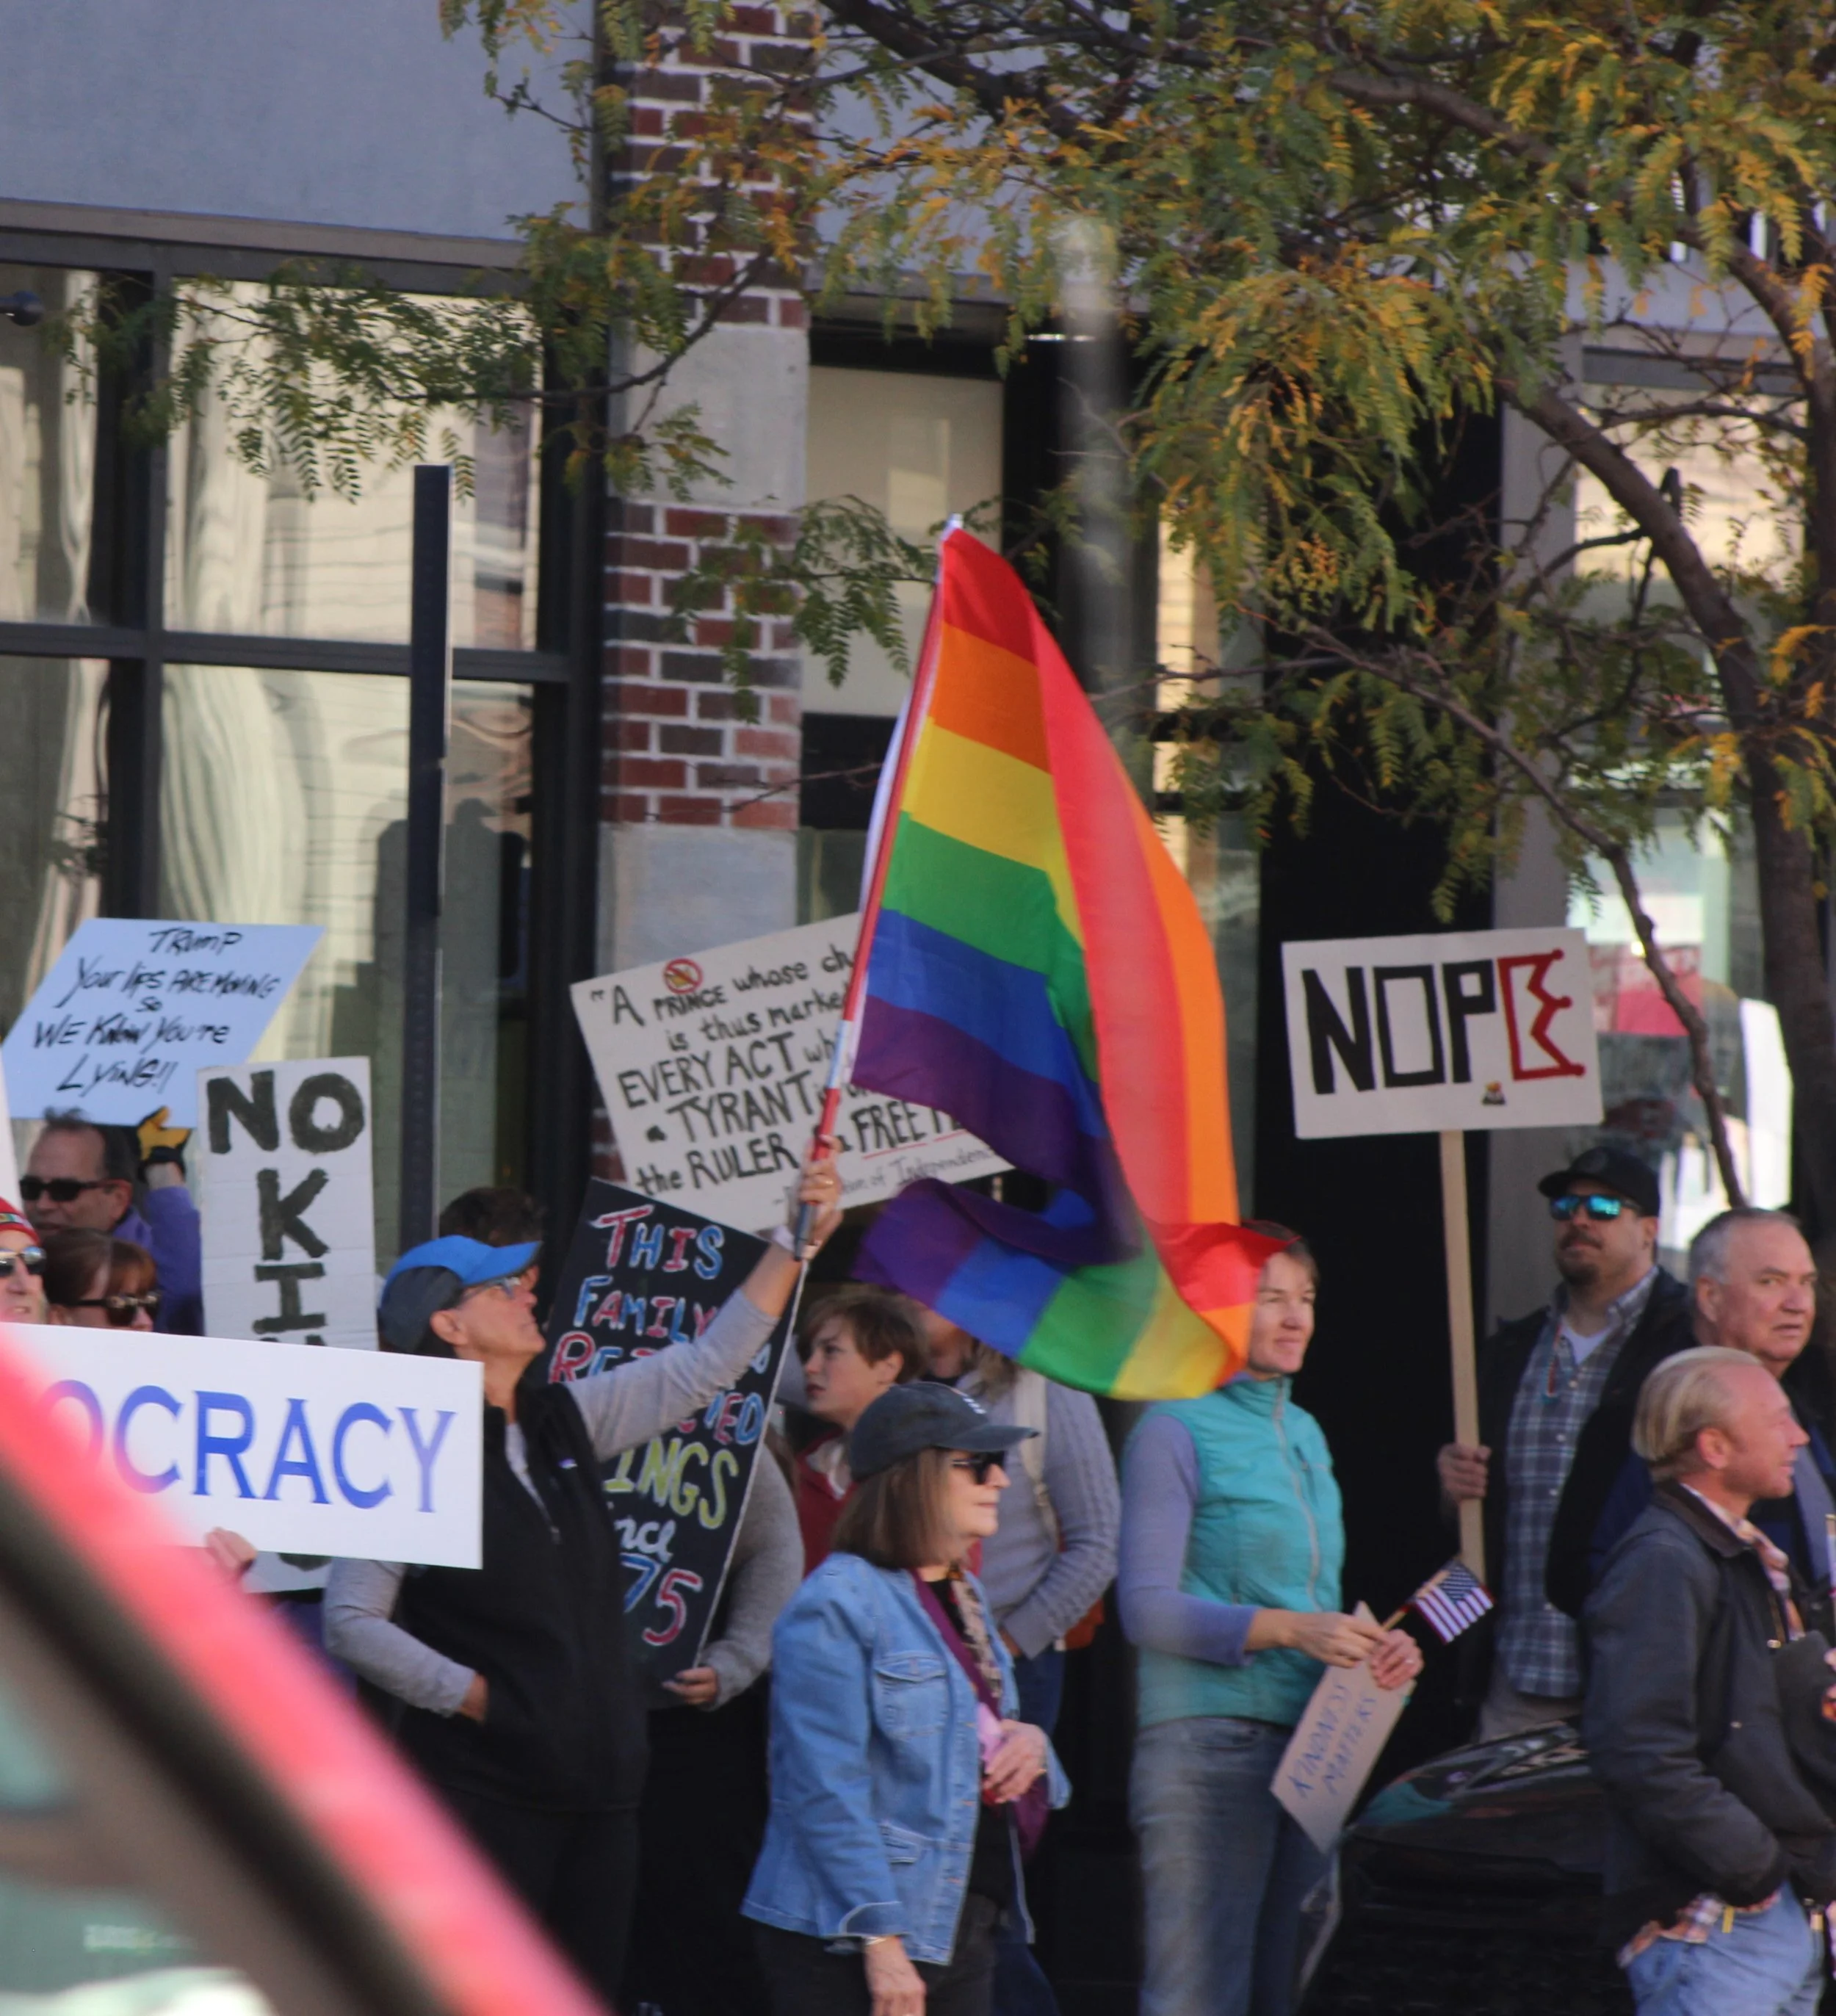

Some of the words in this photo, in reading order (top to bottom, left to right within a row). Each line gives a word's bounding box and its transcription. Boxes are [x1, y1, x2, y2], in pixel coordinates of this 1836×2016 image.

[653, 985, 728, 1021] PRINCE
[733, 961, 809, 991] whose
[1302, 948, 1586, 1095] NOPE
[33, 1014, 87, 1049] WE
[667, 1030, 689, 1052] is
[700, 1013, 763, 1041] thus
[618, 1050, 715, 1109] EVERY
[726, 1031, 795, 1087] ACT
[665, 1070, 814, 1143] TYRANT
[207, 1070, 365, 1155] NO
[636, 1163, 684, 1196] the
[686, 1132, 800, 1190] RULER
[851, 1099, 928, 1152] FREE
[592, 1204, 726, 1279] THIS
[573, 1275, 719, 1344] FAMILY
[618, 1551, 703, 1647] 75
